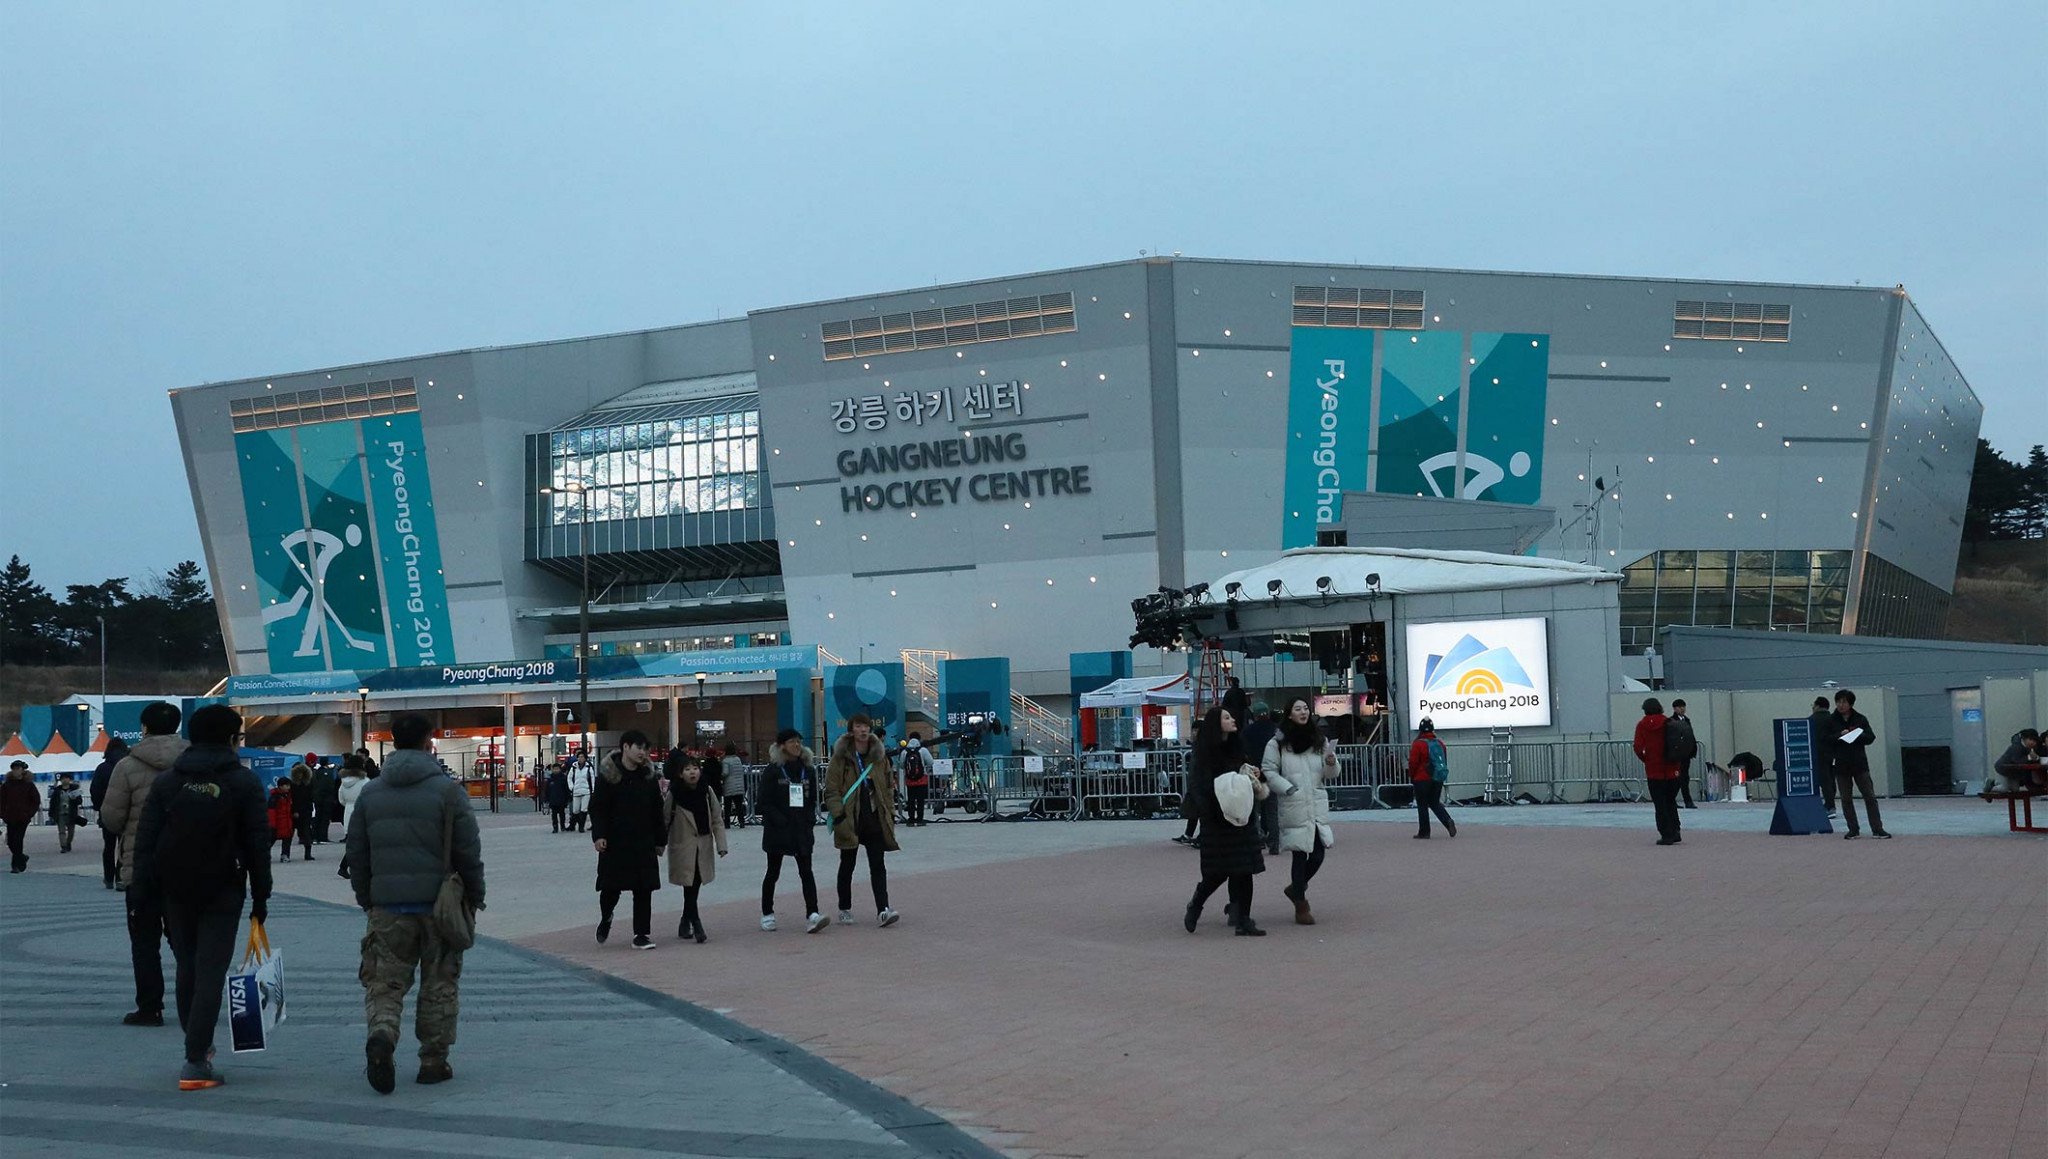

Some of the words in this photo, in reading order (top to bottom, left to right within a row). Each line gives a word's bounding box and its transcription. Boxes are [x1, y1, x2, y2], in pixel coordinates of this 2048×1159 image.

[831, 394, 888, 433] 강릉
[893, 387, 953, 426] 하키
[961, 380, 1021, 420] 센터
[837, 432, 1027, 478] GANGNEUNG
[1313, 359, 1345, 523] PyeongCha
[840, 476, 962, 513] HOCKEY
[968, 465, 1092, 503] CENTRE
[386, 441, 425, 613] PyeongChang
[442, 664, 525, 683] PyeongChang
[526, 662, 555, 676] 2018
[968, 711, 996, 724] 18
[1419, 698, 1507, 713] PyeongChang
[1509, 695, 1540, 707] 2018
[113, 730, 143, 741] Pyeong
[231, 977, 247, 1018] VISA
